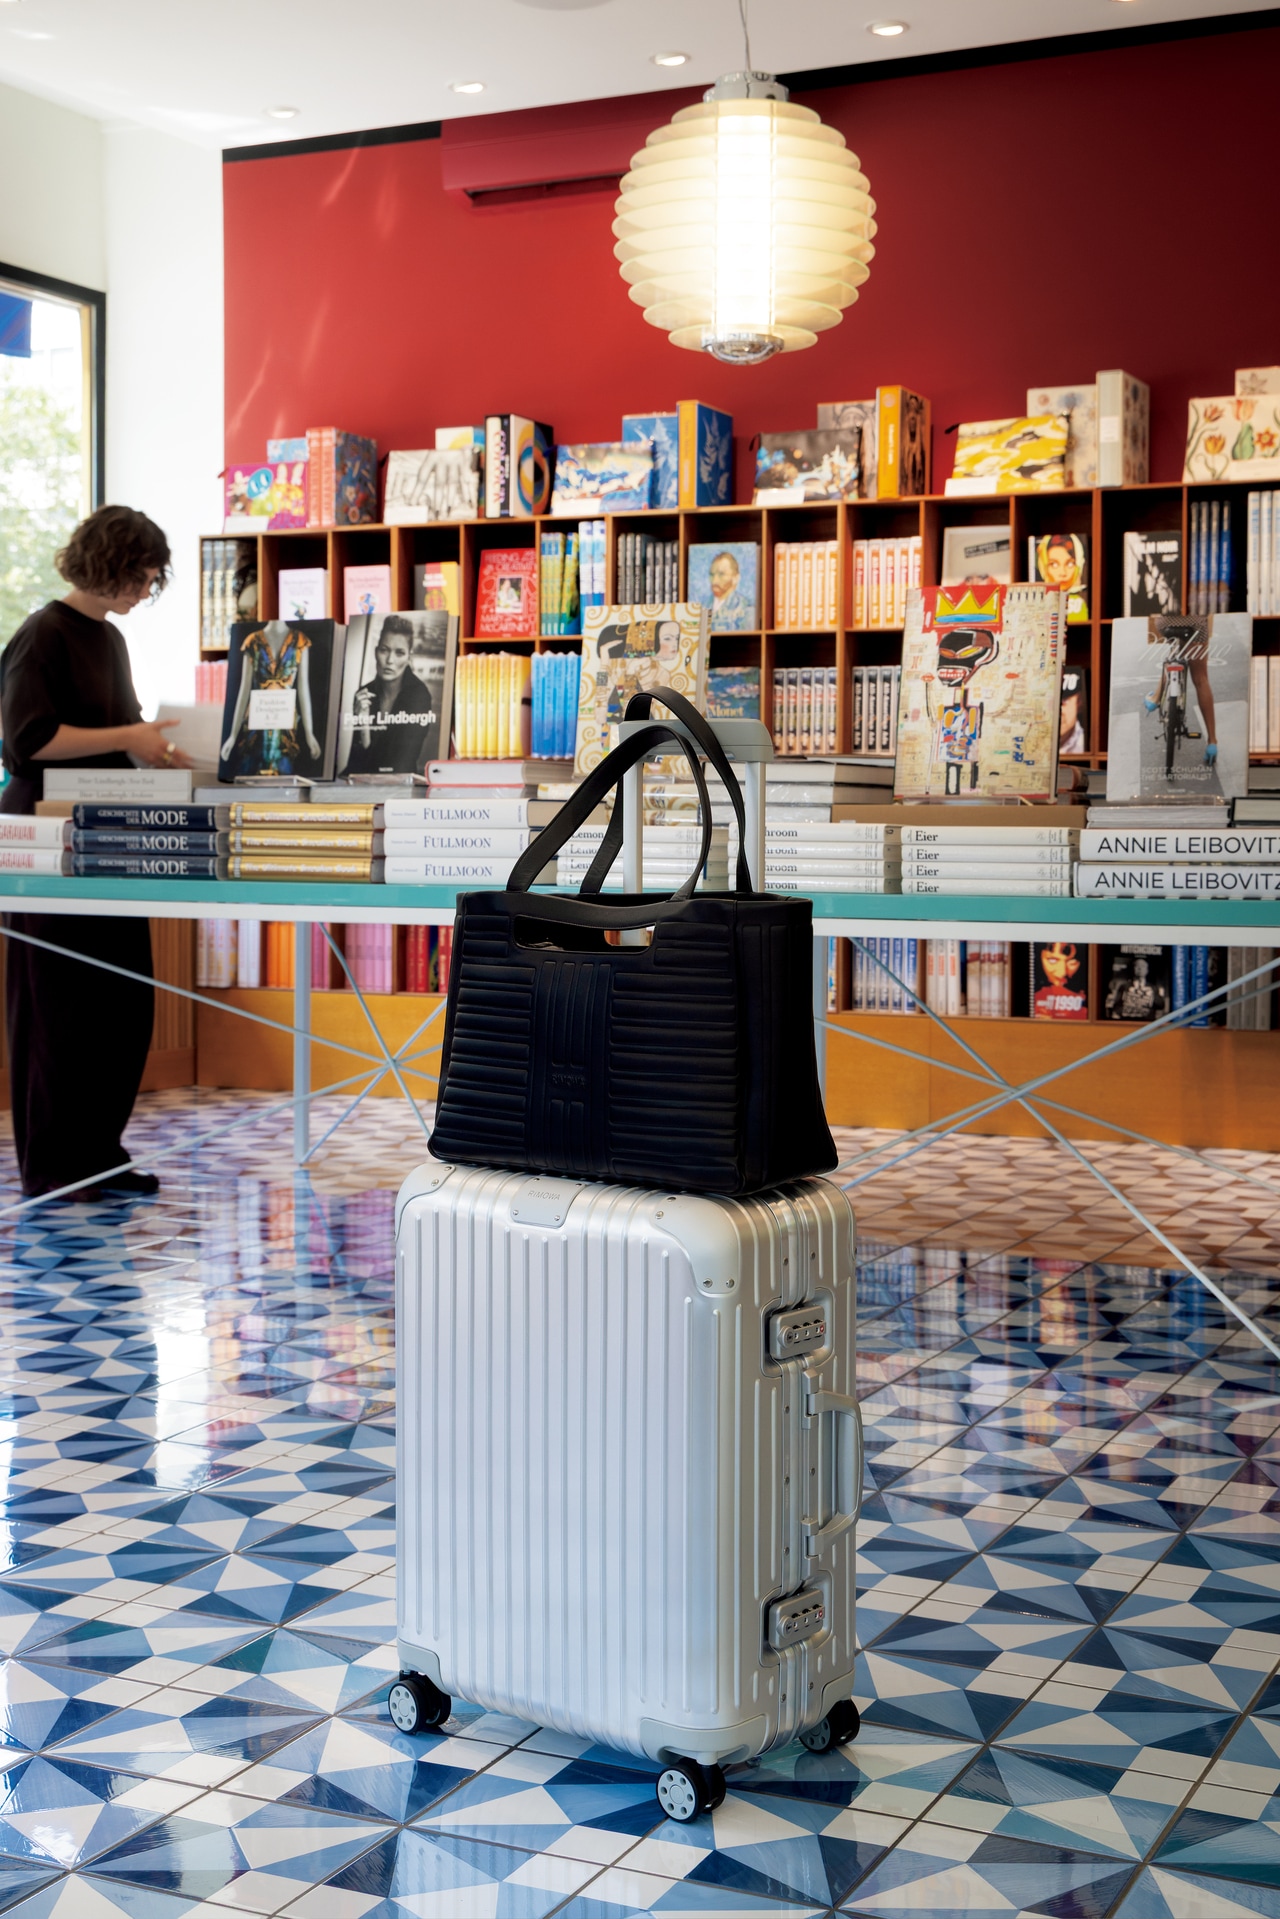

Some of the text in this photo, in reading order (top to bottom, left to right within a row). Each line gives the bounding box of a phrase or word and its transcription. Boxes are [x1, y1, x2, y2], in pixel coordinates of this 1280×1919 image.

[1138, 630, 1233, 663] Milano
[343, 710, 436, 726] Peter Lindbergh
[1141, 766, 1168, 774] SCOTT
[141, 810, 189, 825] MODE
[423, 807, 490, 820] FULLMOON
[142, 835, 189, 850] MODE
[423, 835, 491, 848] FULLMOON
[915, 830, 938, 842] Eier
[1097, 837, 1280, 854] ANNIE LEIBOVIT
[916, 849, 939, 860] Eier
[142, 860, 189, 874] MODE
[424, 863, 493, 876] FULLMOON
[916, 865, 939, 876] Eier
[916, 881, 939, 893] Eier
[1094, 872, 1164, 889] ANNIE
[527, 1190, 561, 1200] RIMOWA
